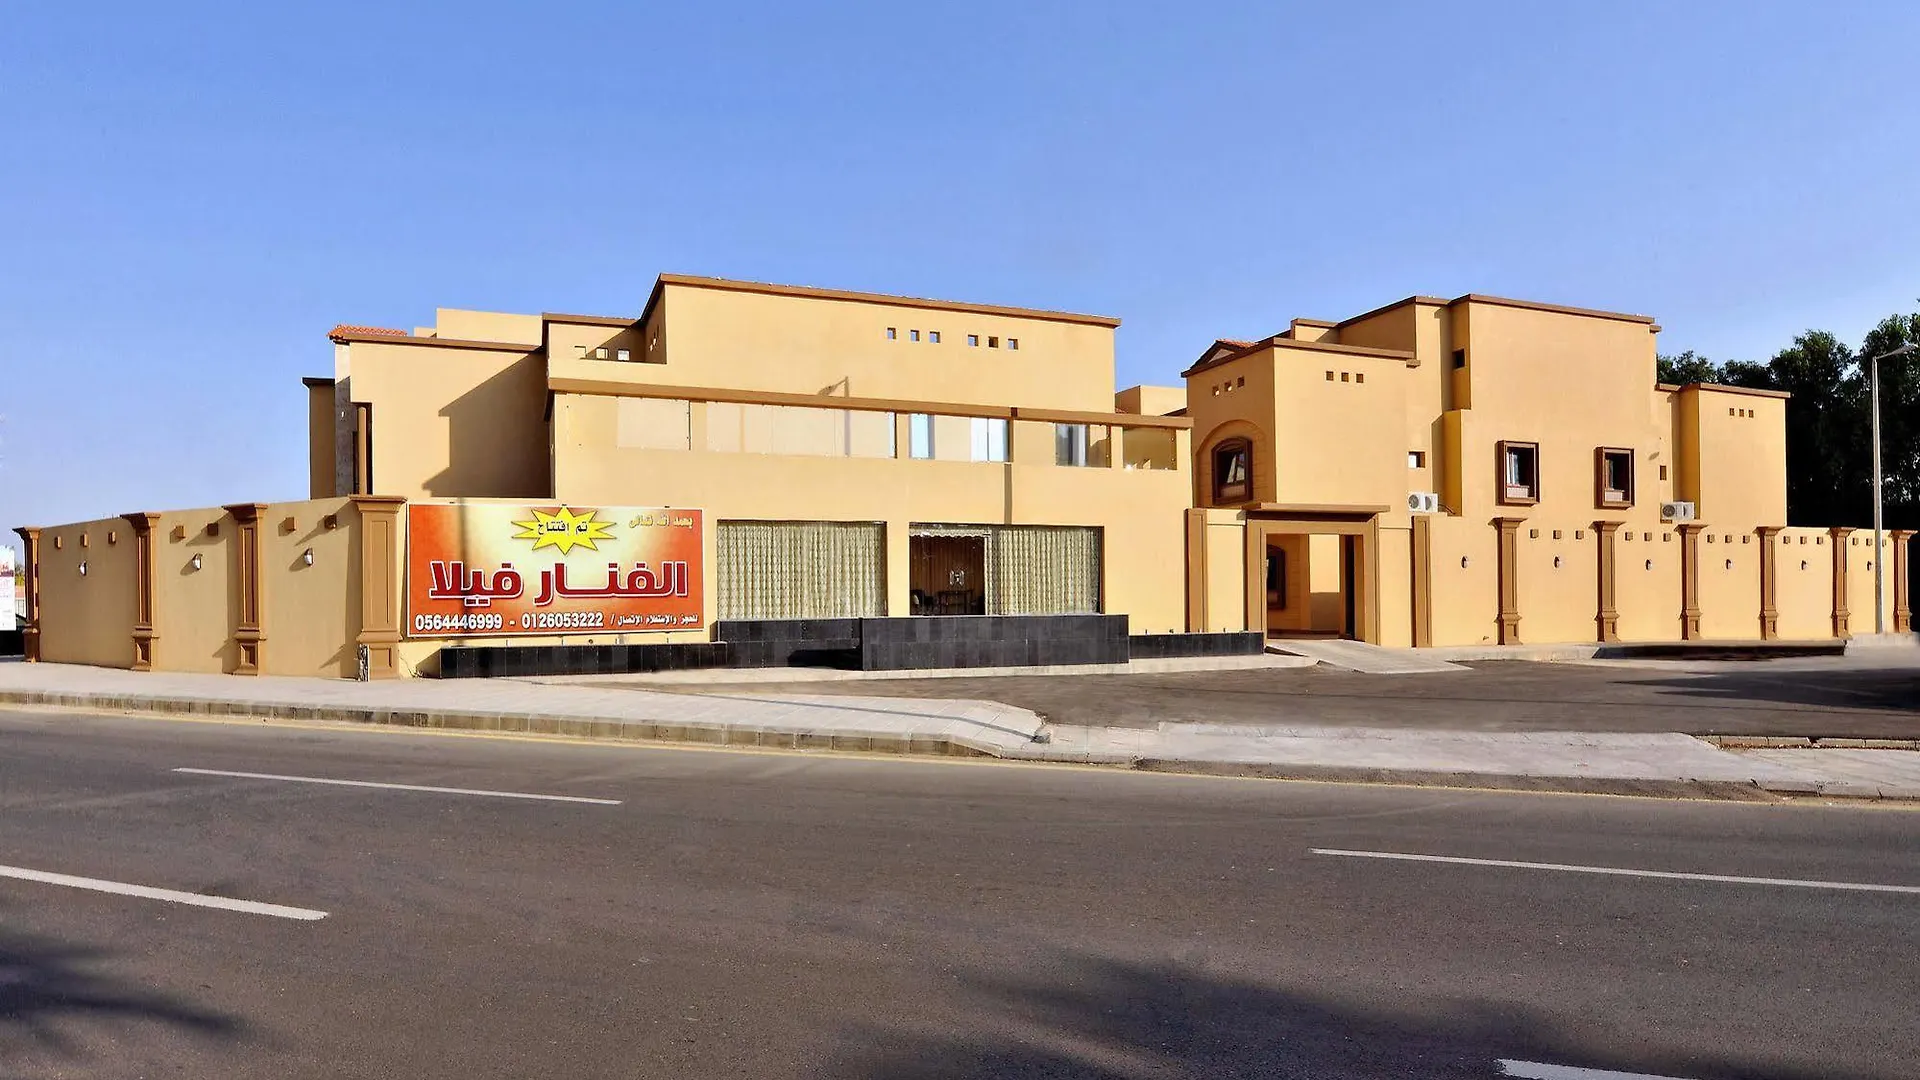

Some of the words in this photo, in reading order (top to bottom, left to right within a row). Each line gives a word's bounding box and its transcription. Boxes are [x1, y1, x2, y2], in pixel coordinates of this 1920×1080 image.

[575, 521, 588, 535] تم
[429, 560, 524, 607] فيلا
[533, 560, 688, 607] الفنار
[414, 613, 503, 631] 0564446999
[521, 612, 604, 629] 0126053222
